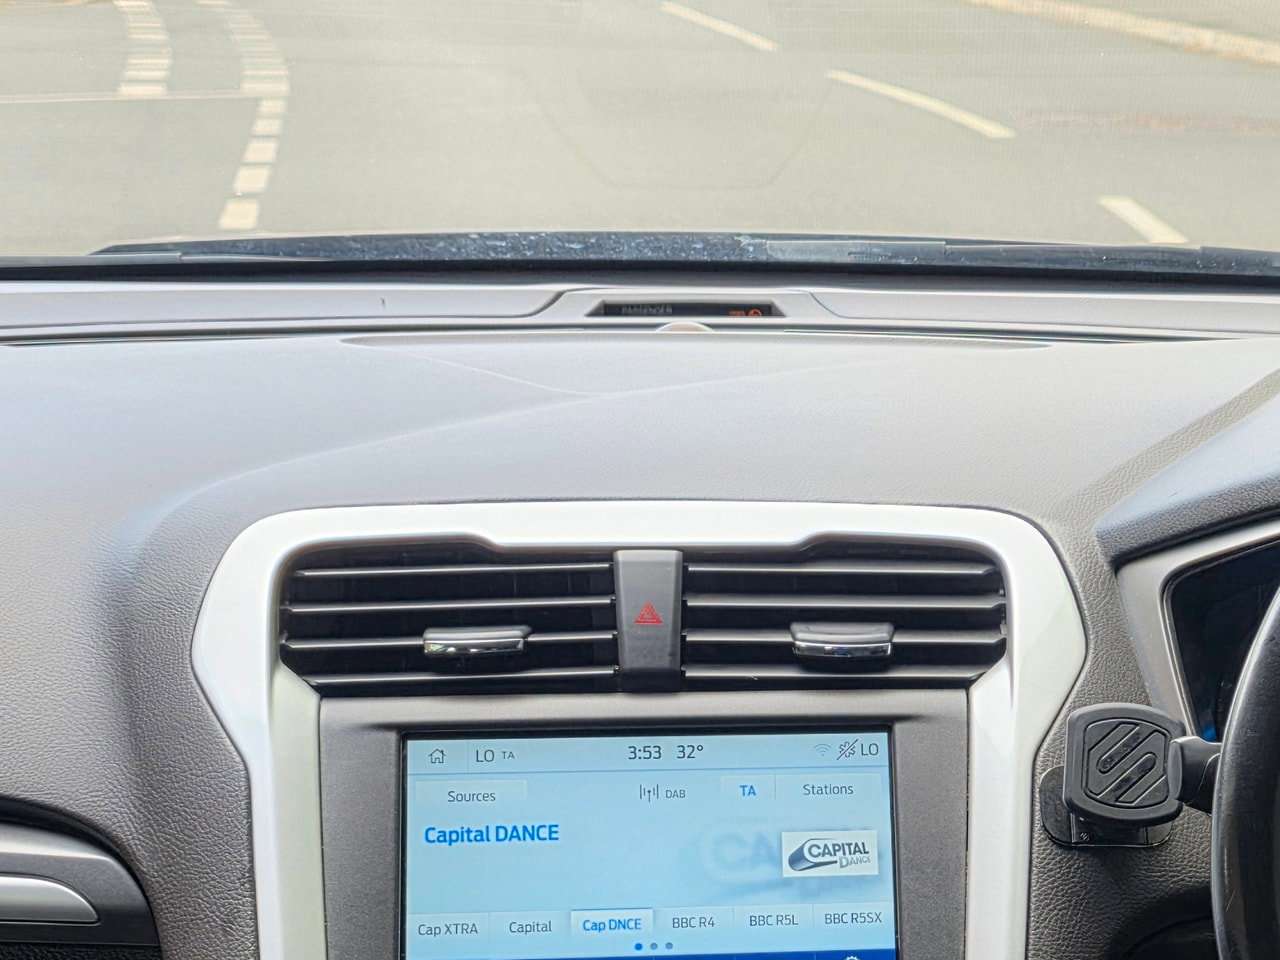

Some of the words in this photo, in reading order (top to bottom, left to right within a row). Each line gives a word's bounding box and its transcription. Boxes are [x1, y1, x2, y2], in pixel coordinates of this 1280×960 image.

[475, 749, 495, 763] LO
[501, 751, 516, 760] TA
[627, 745, 662, 760] 3:53
[676, 744, 704, 759] 32°
[860, 743, 879, 756] LO
[665, 789, 686, 799] DAB
[739, 784, 757, 797] TA
[802, 783, 854, 796] Stations
[447, 790, 496, 803] Sources
[424, 826, 490, 846] Capital
[495, 824, 559, 842] DANCE
[807, 841, 870, 858] CAPITAL
[672, 917, 697, 929] BBC
[699, 917, 715, 928] R4
[749, 915, 773, 927] BBC
[776, 914, 799, 926] R5L
[824, 912, 848, 925] BBC
[851, 912, 882, 924] R5SX
[418, 924, 443, 937] Cap
[444, 923, 478, 935] XTRA
[509, 920, 552, 935] Capital
[583, 919, 606, 933] Cap
[609, 918, 642, 930] DNCE
